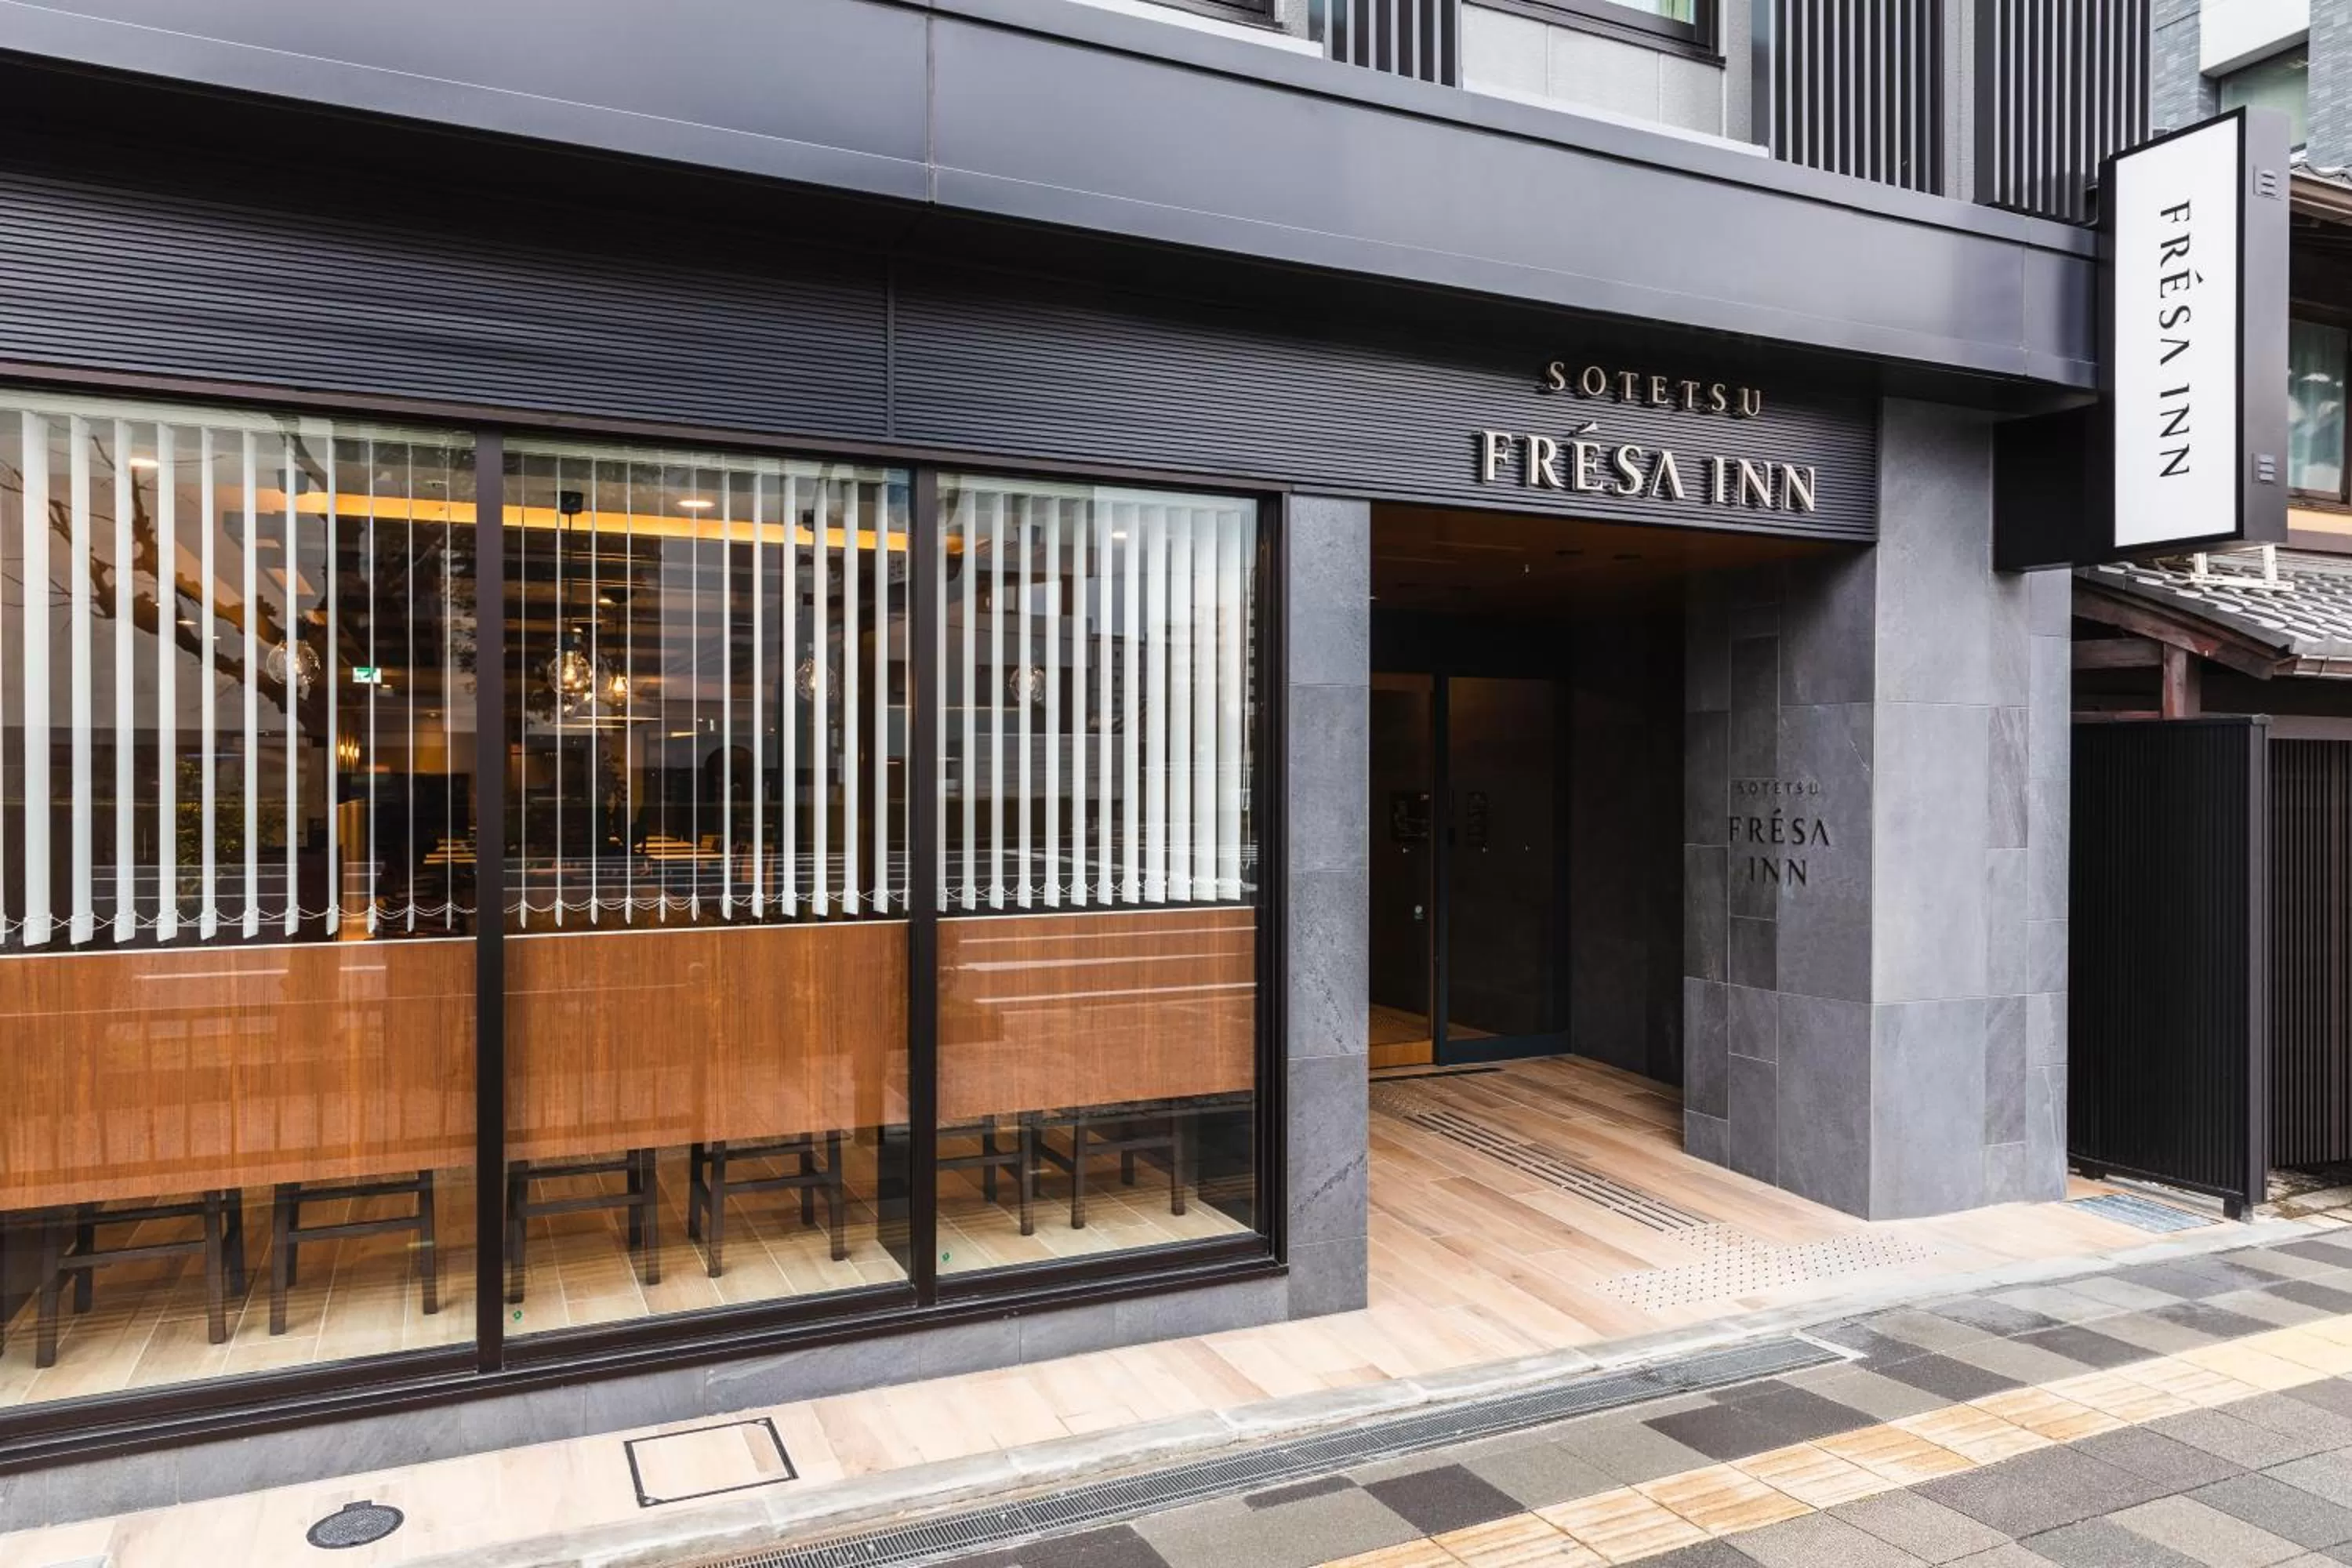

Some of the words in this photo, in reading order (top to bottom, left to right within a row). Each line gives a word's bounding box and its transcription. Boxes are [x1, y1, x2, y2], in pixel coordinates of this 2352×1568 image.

[2158, 198, 2204, 366] FRÉSA
[1548, 361, 1762, 417] SOTETSU
[2159, 382, 2190, 478] INN
[1481, 420, 1686, 501] FRÉSA
[1711, 455, 1816, 513] INN
[1736, 781, 1819, 795] SOTETSU
[1728, 808, 1830, 847] FRÉSA
[1749, 855, 1806, 886] INN
